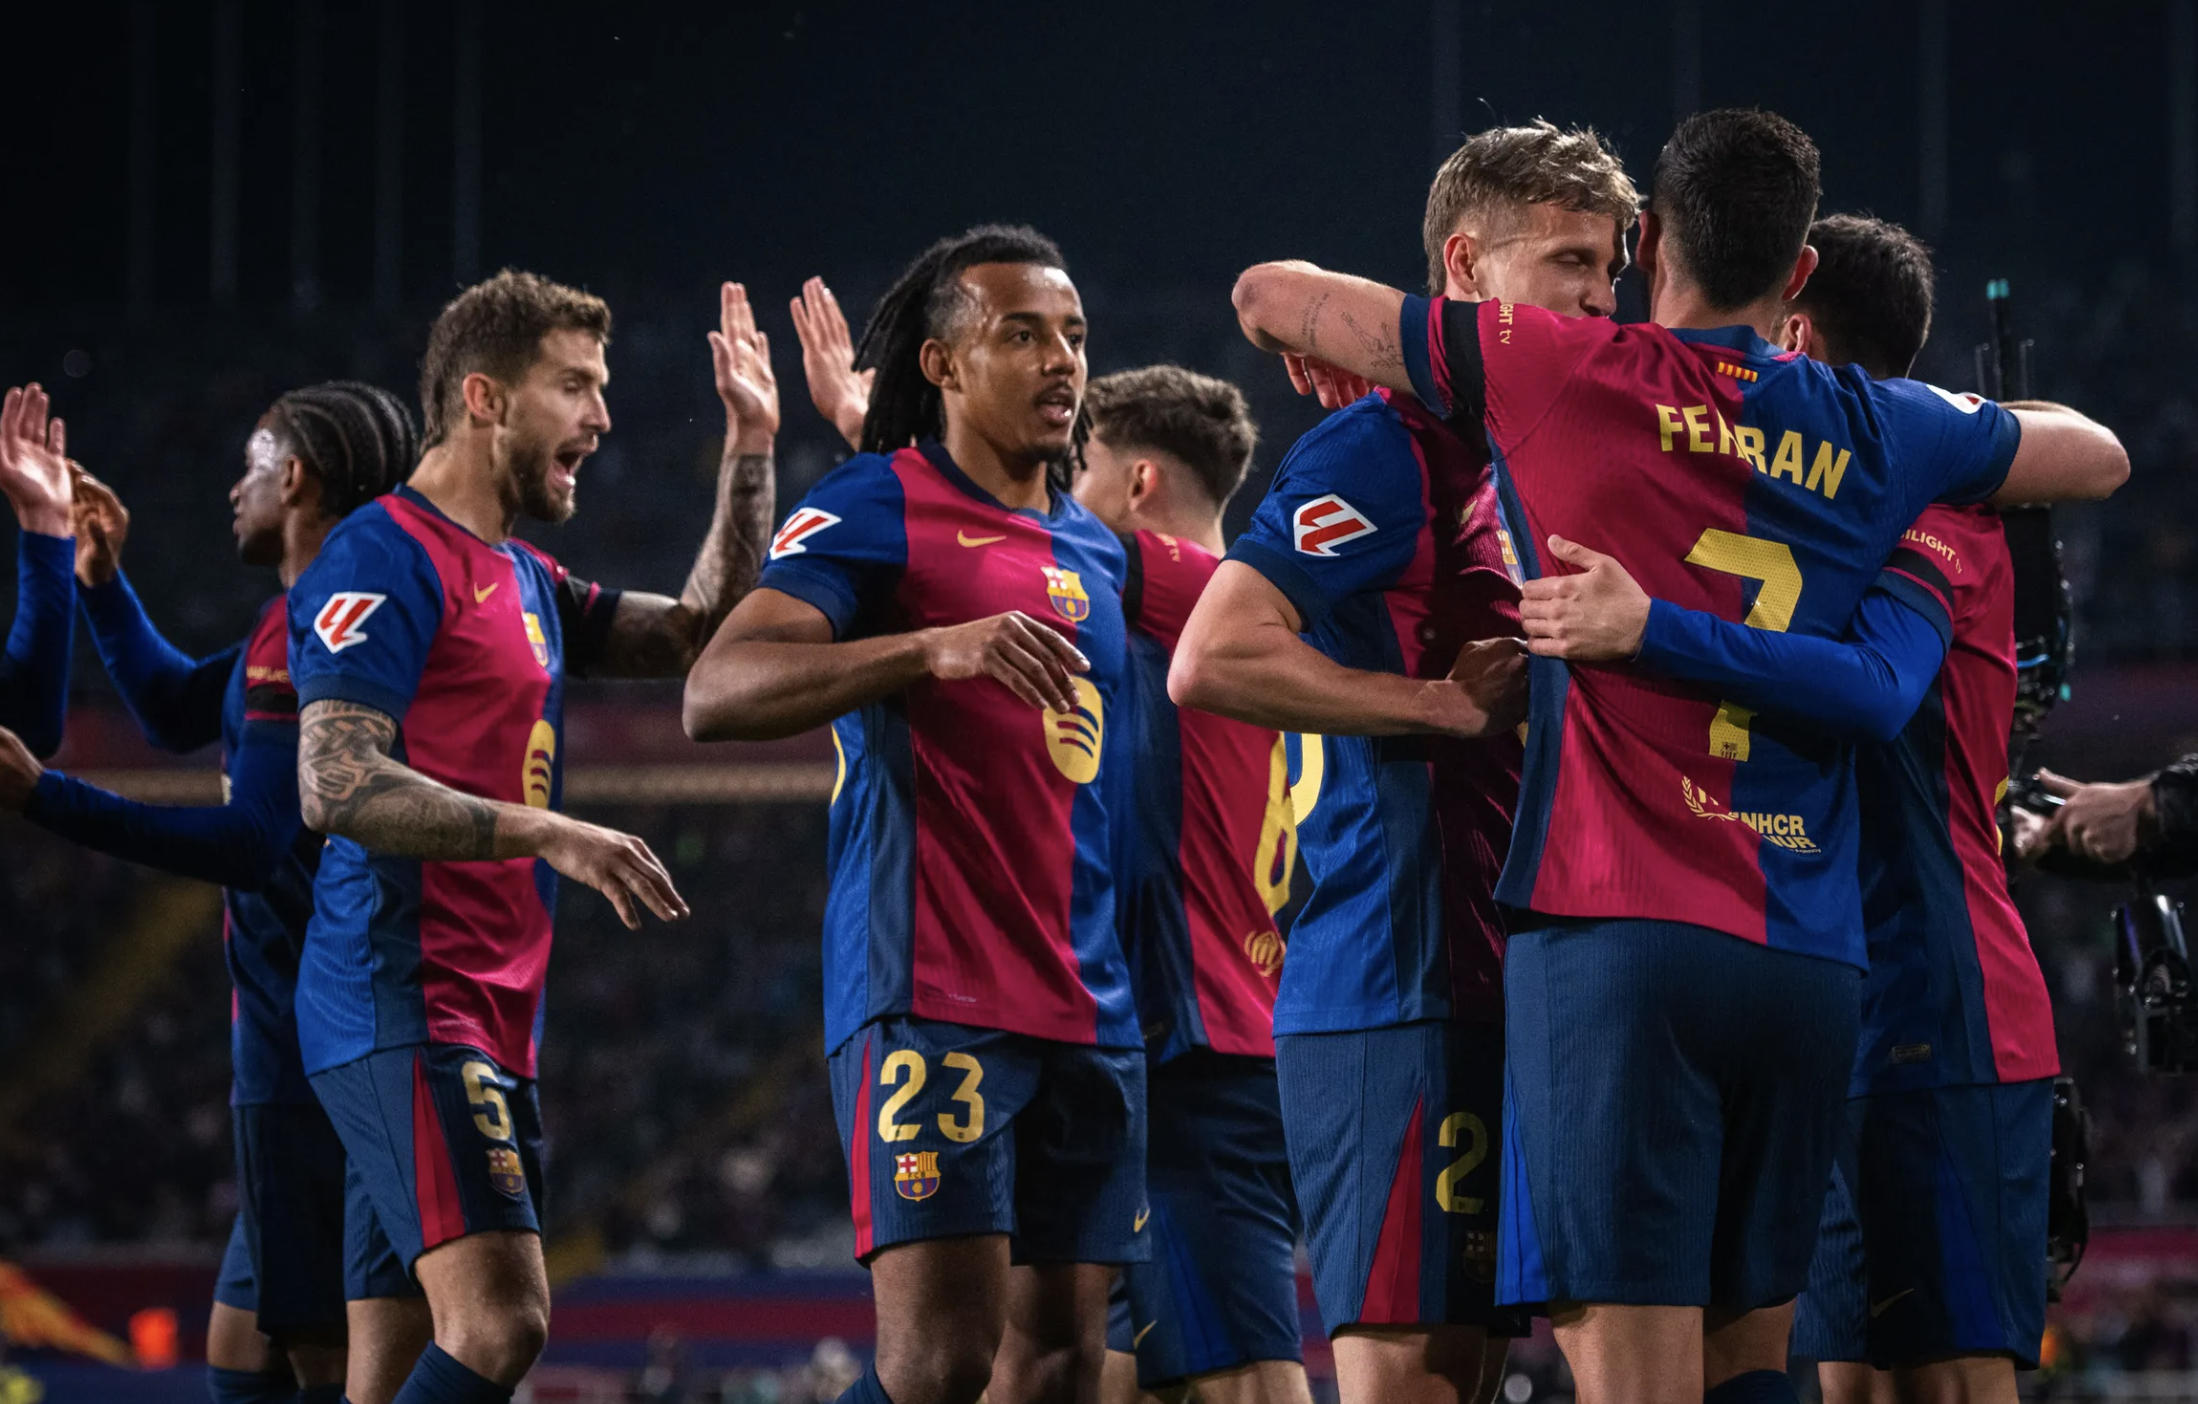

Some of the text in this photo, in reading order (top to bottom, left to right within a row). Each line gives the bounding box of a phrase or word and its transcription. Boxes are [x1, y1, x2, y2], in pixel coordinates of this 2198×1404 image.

[1499, 303, 1514, 325] GHT
[1901, 528, 1956, 562] ILIGHT
[1728, 811, 1806, 836] NHCR
[461, 1061, 511, 1140] 5
[878, 1049, 985, 1143] 23
[1436, 1111, 1488, 1215] 2
